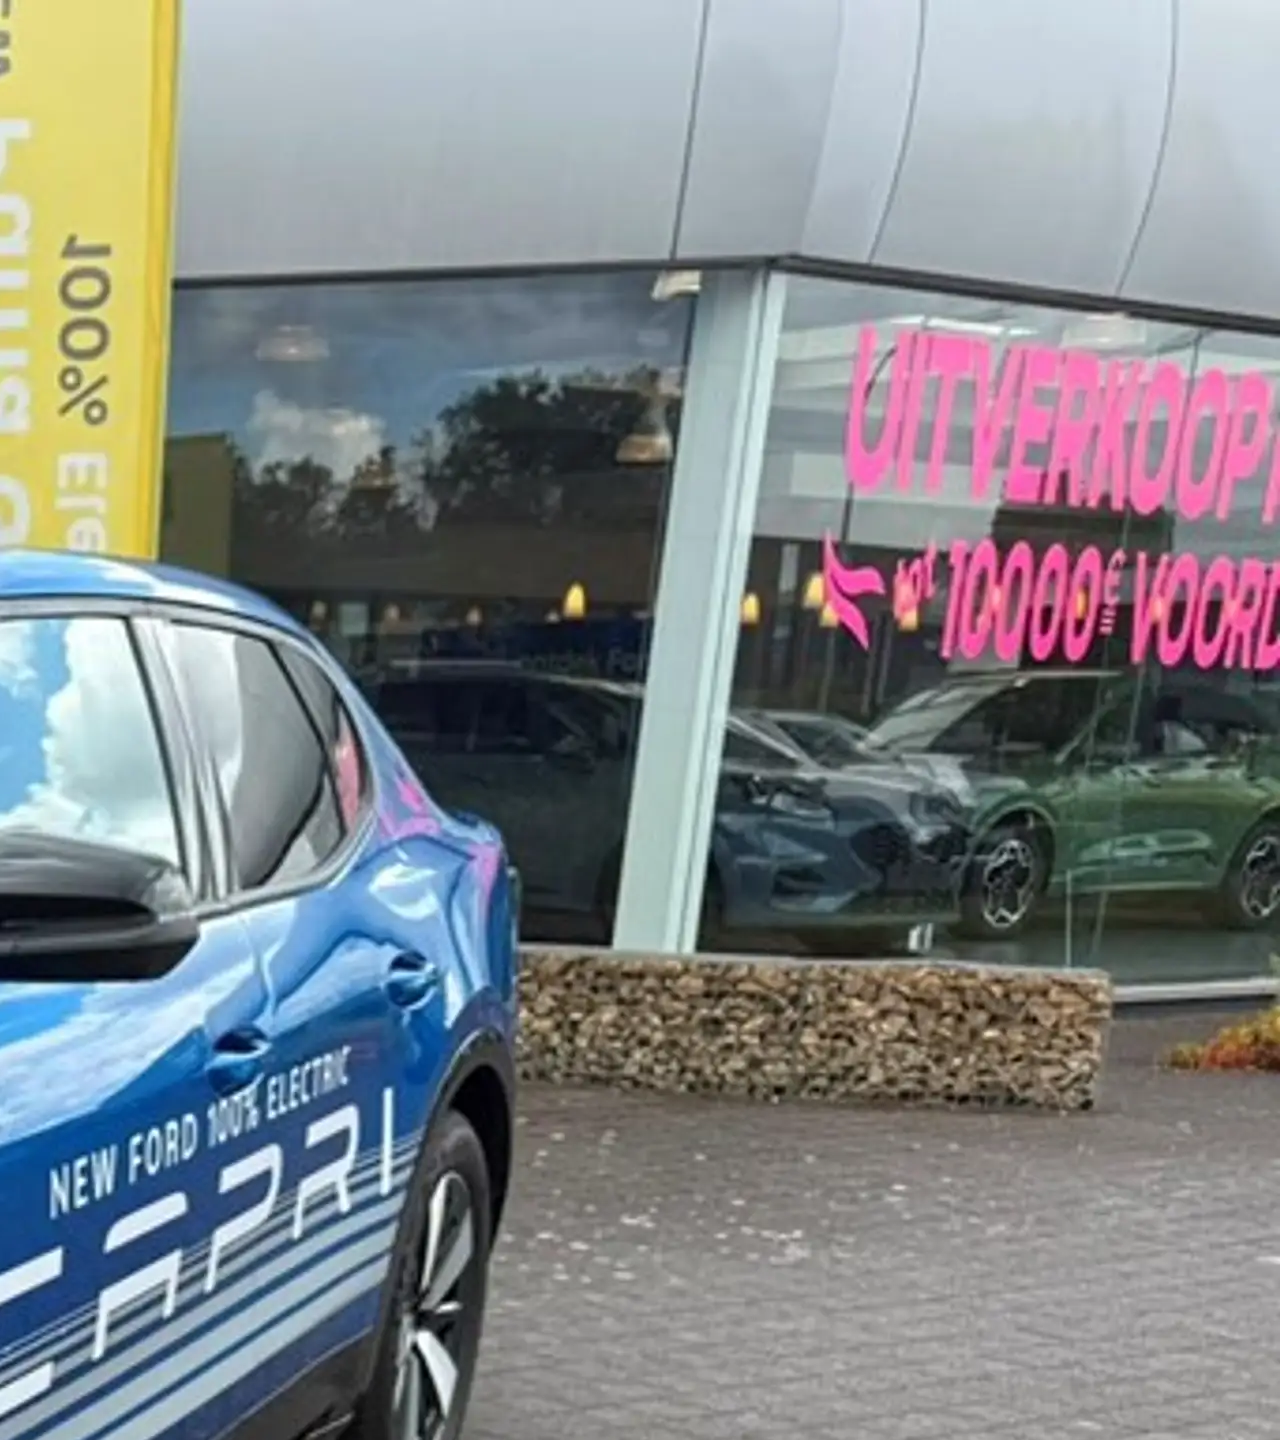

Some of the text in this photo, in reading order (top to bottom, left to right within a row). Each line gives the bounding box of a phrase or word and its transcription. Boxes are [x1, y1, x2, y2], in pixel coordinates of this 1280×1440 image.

[844, 322, 1280, 525] UITVERKOOP
[48, 1045, 352, 1220] NEW FORD 100% ELECTRIC
